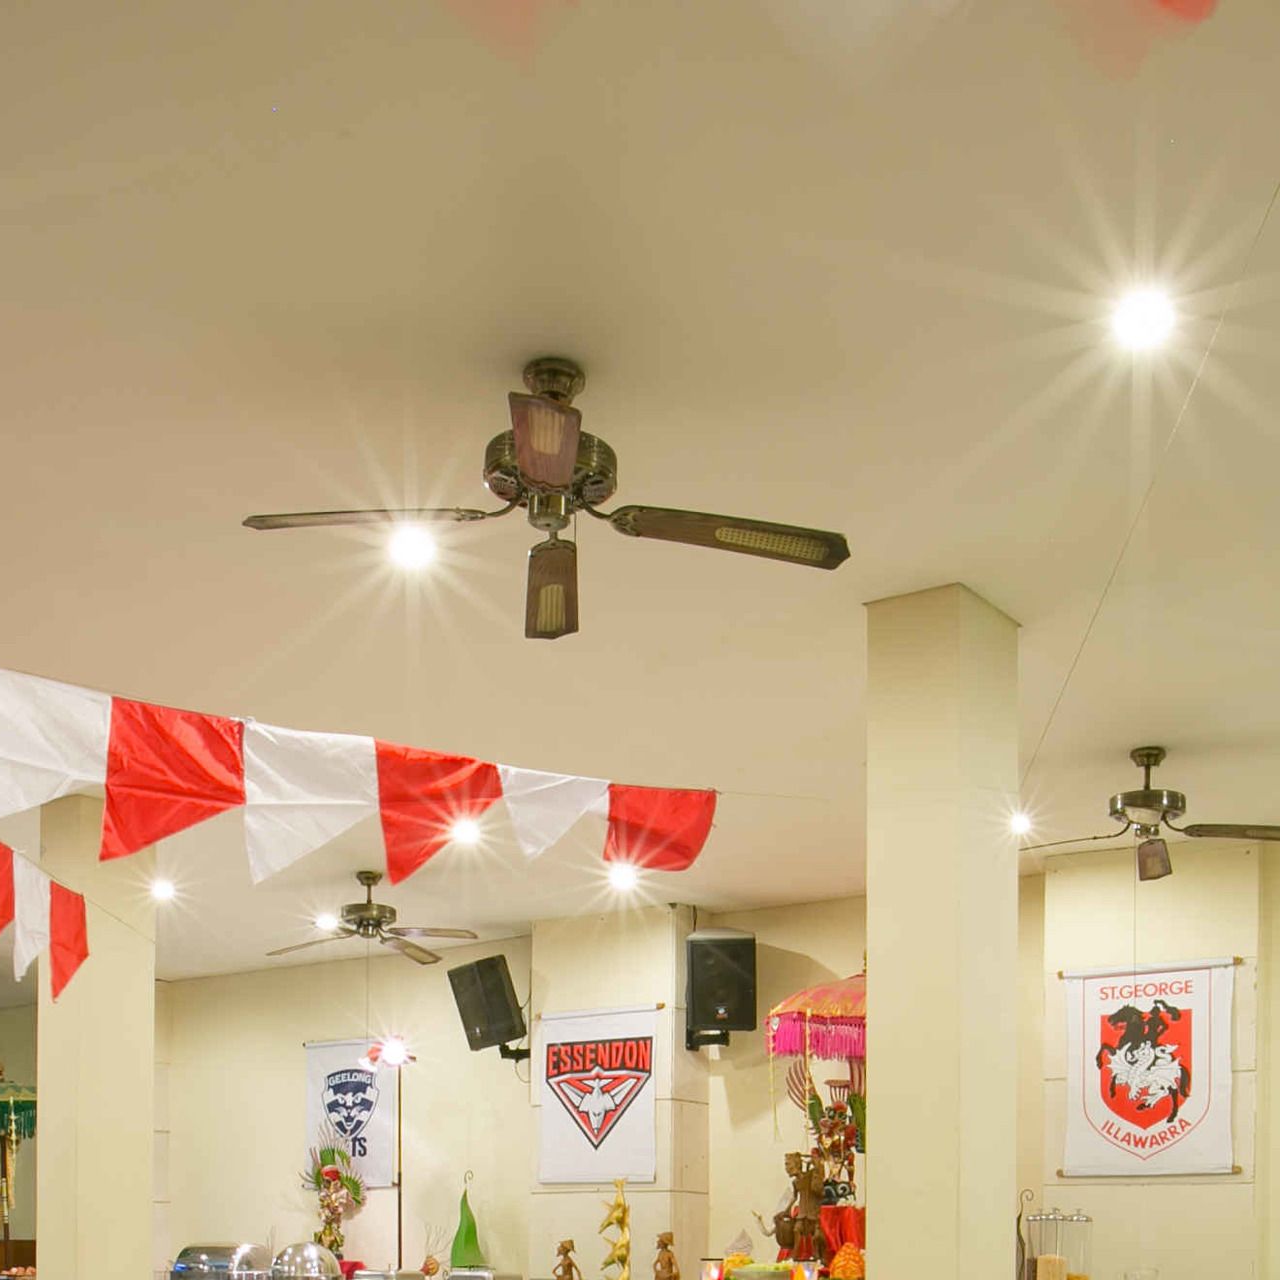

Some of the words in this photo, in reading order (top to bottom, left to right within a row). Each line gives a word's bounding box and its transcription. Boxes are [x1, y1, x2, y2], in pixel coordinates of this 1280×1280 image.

[1100, 980, 1193, 1001] ST.GEORGE
[548, 1039, 651, 1077] ESSENDON
[328, 1072, 372, 1087] GEELONG
[1100, 1118, 1192, 1149] ILLAWARRA
